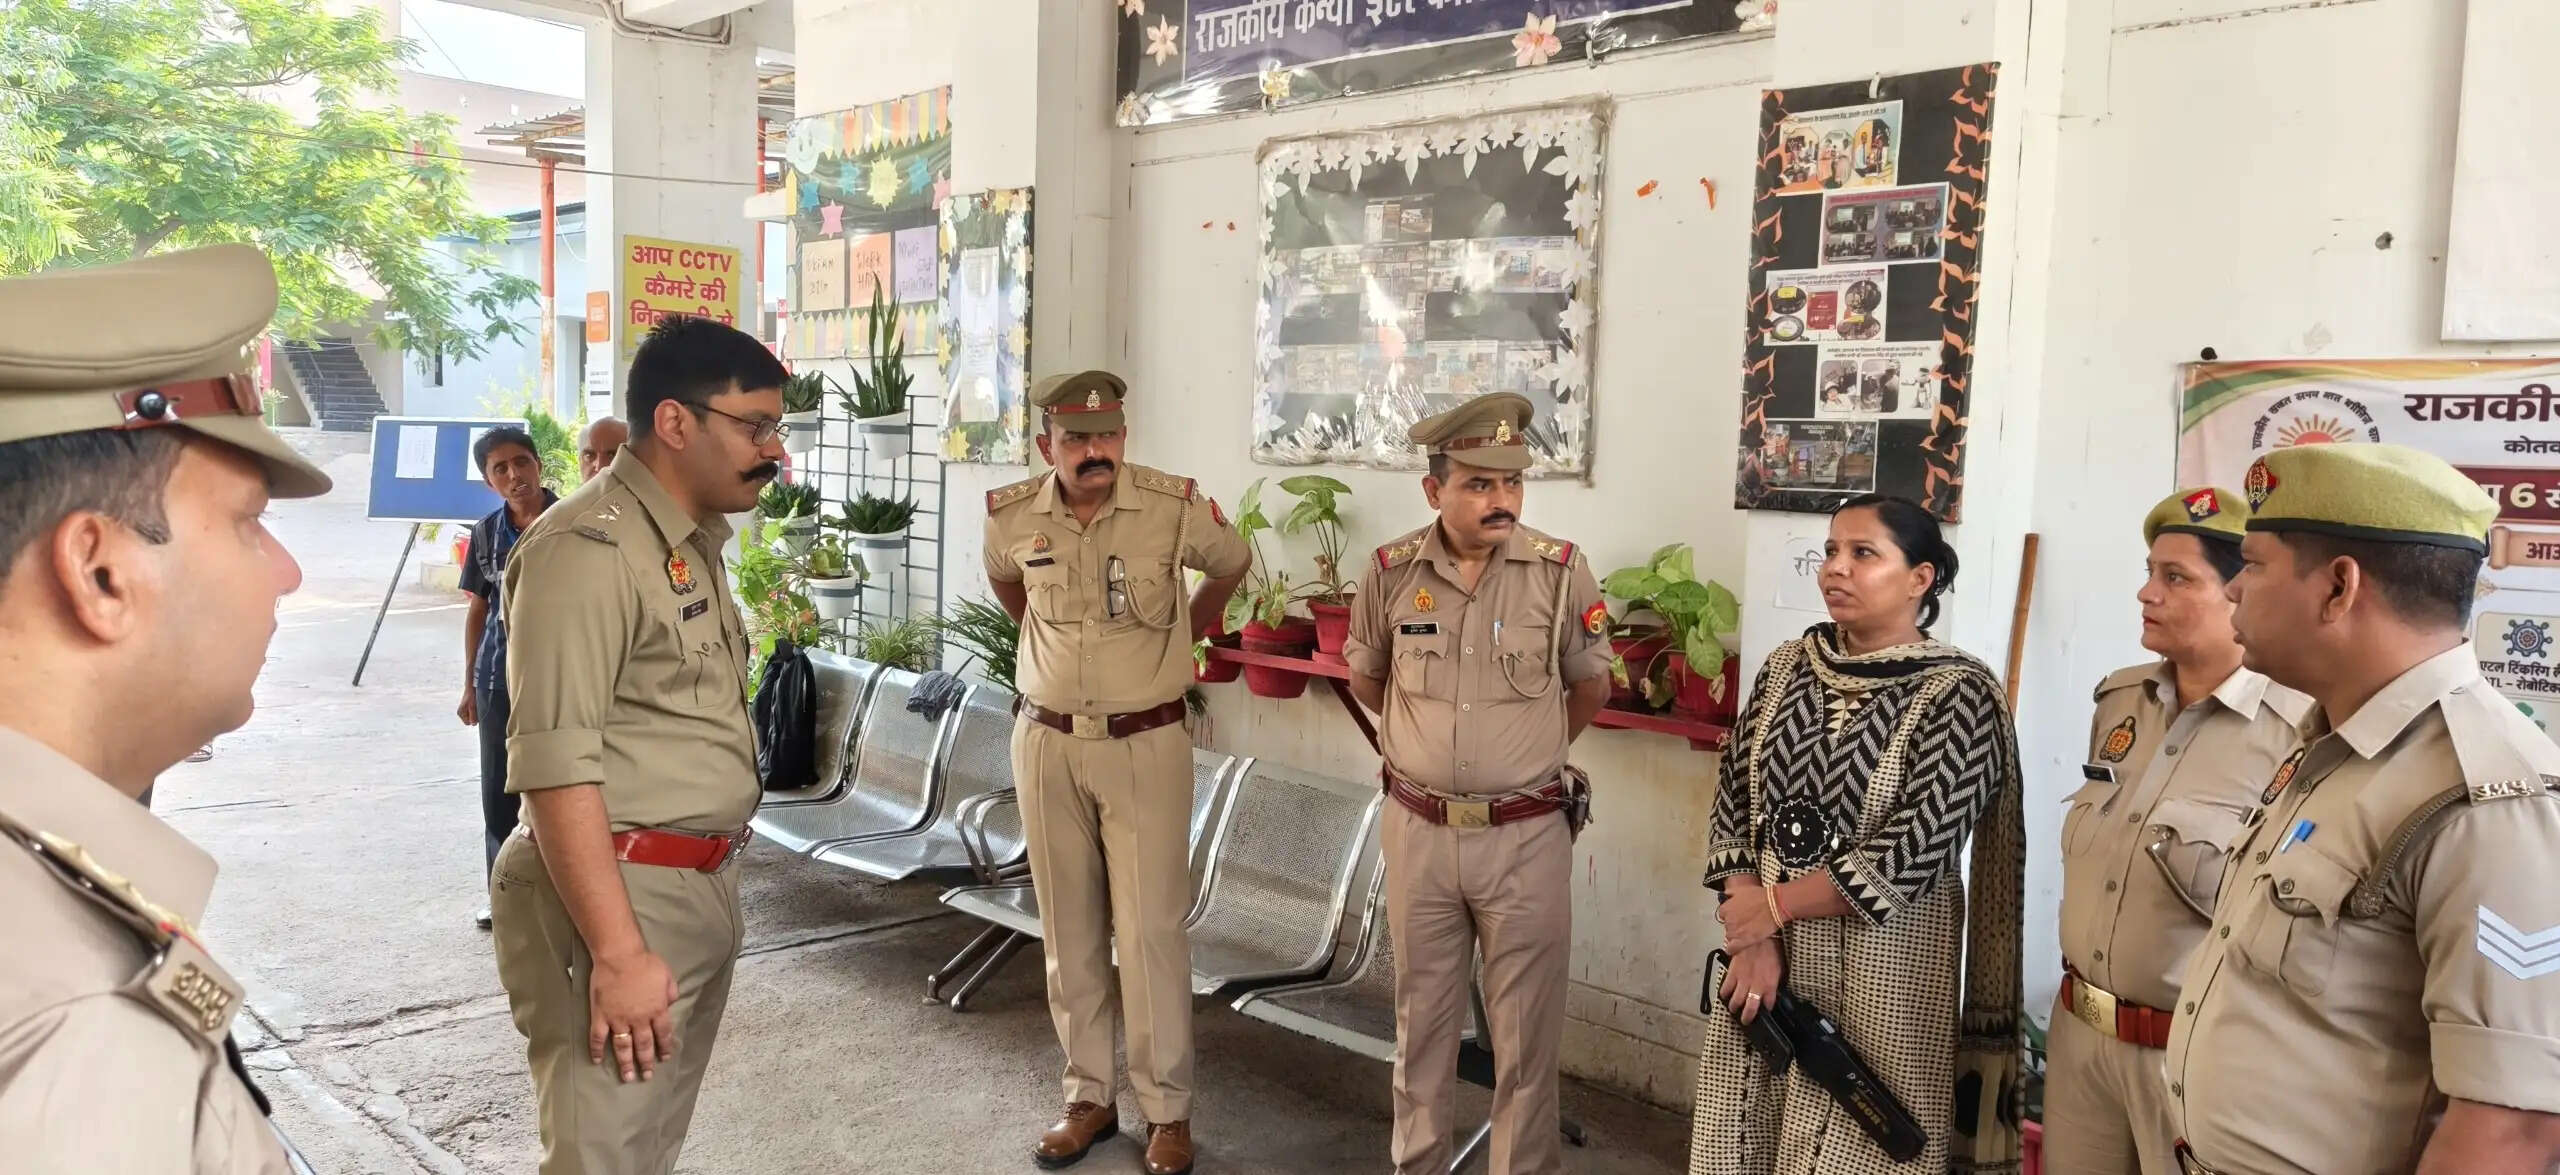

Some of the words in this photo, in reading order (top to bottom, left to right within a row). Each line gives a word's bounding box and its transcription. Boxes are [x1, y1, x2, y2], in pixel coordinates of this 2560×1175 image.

[631, 245, 674, 266] आप
[679, 249, 733, 272] CCTV
[644, 270, 697, 299] कैमरे
[699, 277, 728, 302] की
[2403, 383, 2560, 422] राजकी
[2510, 482, 2537, 508] 6
[2485, 676, 2502, 688] TL
